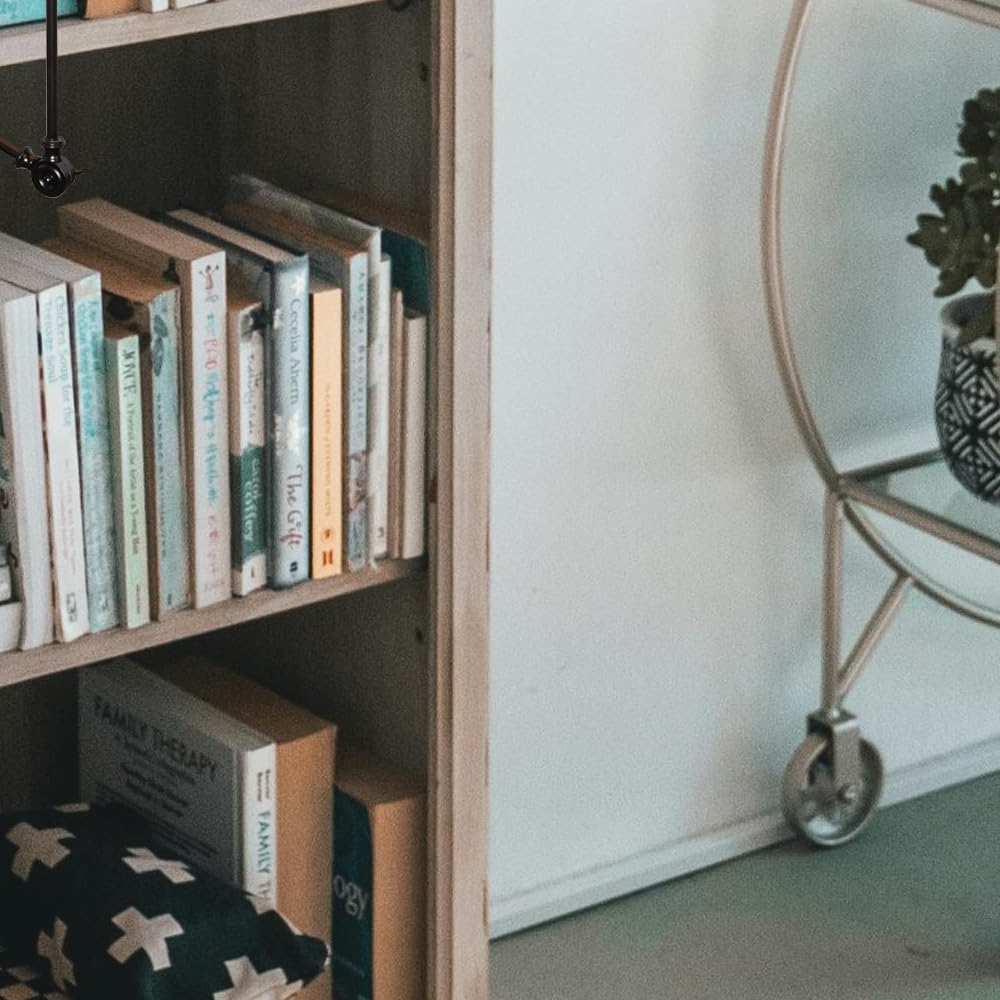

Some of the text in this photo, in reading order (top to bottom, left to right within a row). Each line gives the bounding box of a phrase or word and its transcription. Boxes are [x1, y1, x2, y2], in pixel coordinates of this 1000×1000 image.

[290, 298, 301, 406] Cecelia Ahern
[279, 463, 304, 550] The Gift
[256, 810, 272, 875] FAMILY
[333, 873, 369, 921] ogy
